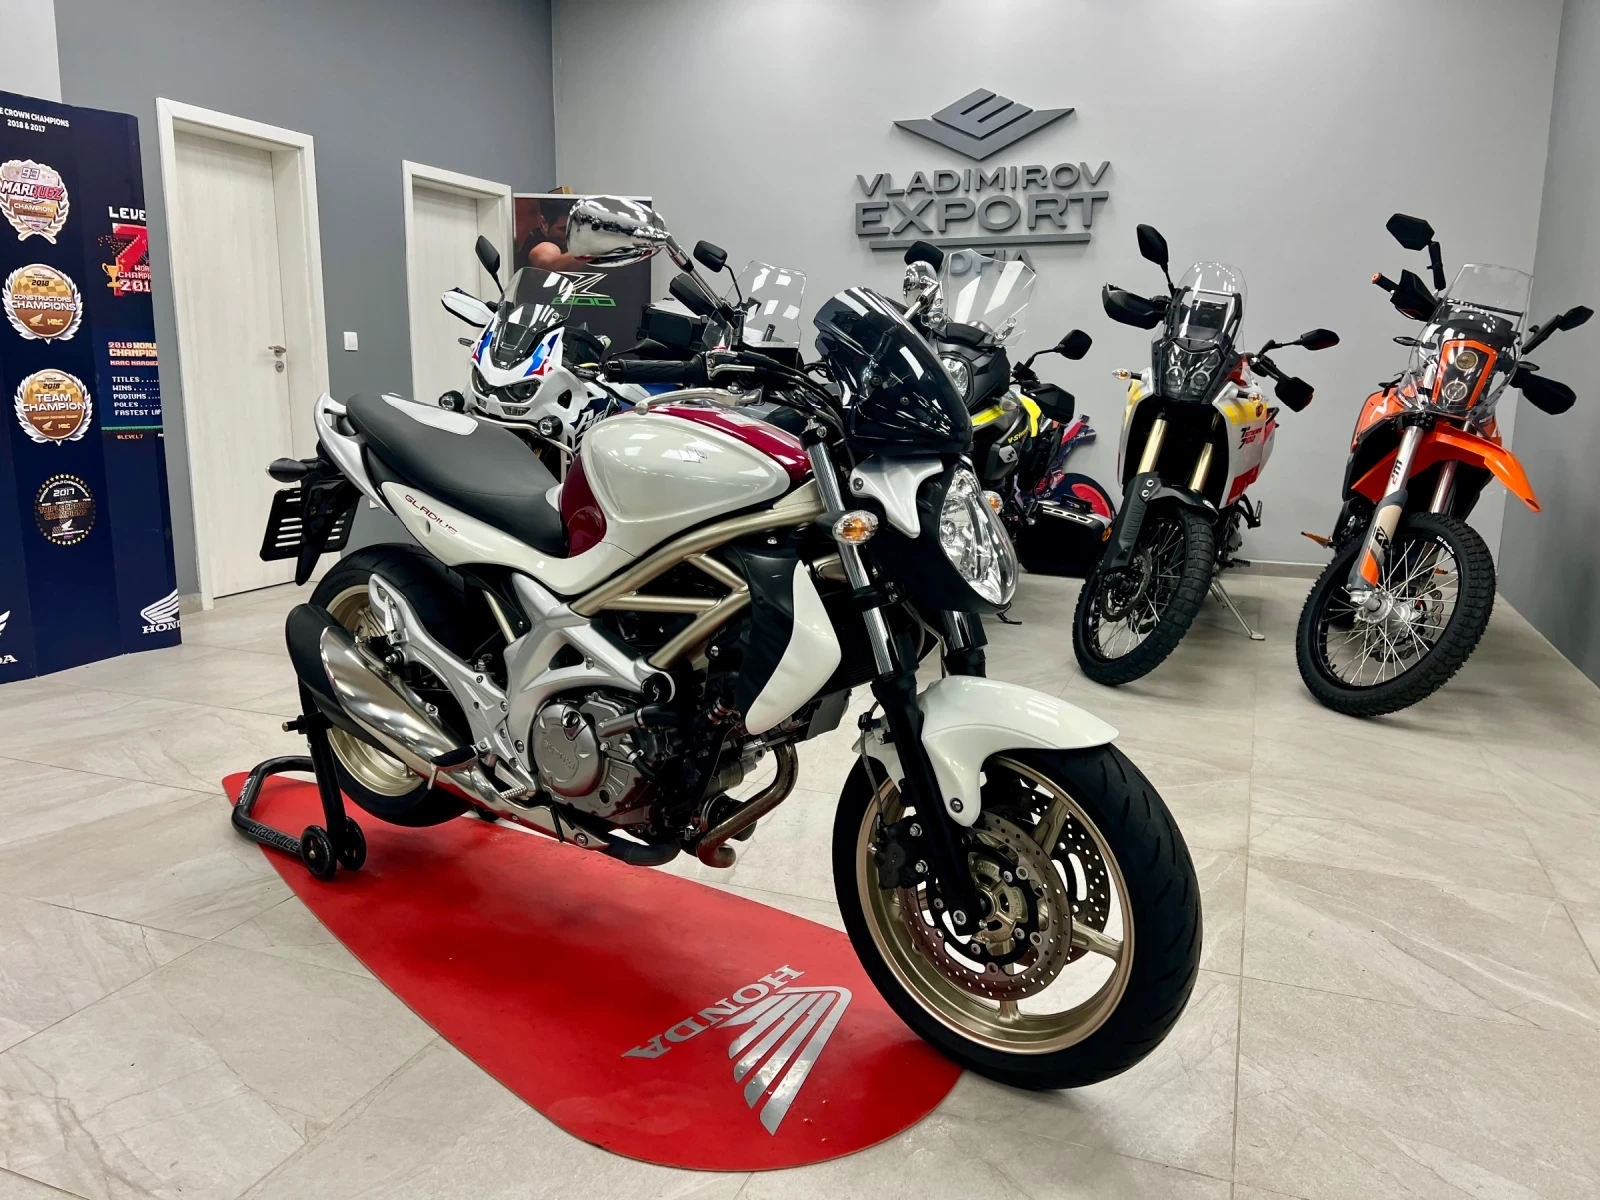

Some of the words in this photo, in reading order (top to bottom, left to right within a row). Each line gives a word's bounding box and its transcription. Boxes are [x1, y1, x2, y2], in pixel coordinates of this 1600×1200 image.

[4, 108, 30, 120] CROWN
[30, 113, 70, 127] CHAMPIONS
[7, 119, 24, 129] 2018
[24, 122, 30, 130] &
[30, 123, 46, 132] 2017
[21, 167, 39, 180] 93
[856, 161, 1111, 197] VLADIMIROV
[1, 180, 65, 201] MARQUEZ
[13, 202, 54, 213] CHAMPION
[108, 206, 146, 221] LEVE
[855, 191, 1109, 235] EXPORT
[949, 248, 1036, 275] OFIA
[31, 279, 50, 287] 2018
[120, 280, 151, 293] 201
[13, 294, 72, 303] CONSTRUCTORS
[11, 300, 77, 311] CHAMPIONS
[108, 341, 132, 349] 2018
[35, 393, 73, 403] TEAM
[23, 402, 87, 412] CHAMPION
[53, 487, 75, 497] 2017
[404, 494, 458, 535] GLADIUS
[142, 621, 181, 634] HON
[621, 964, 805, 1059] HONDA
